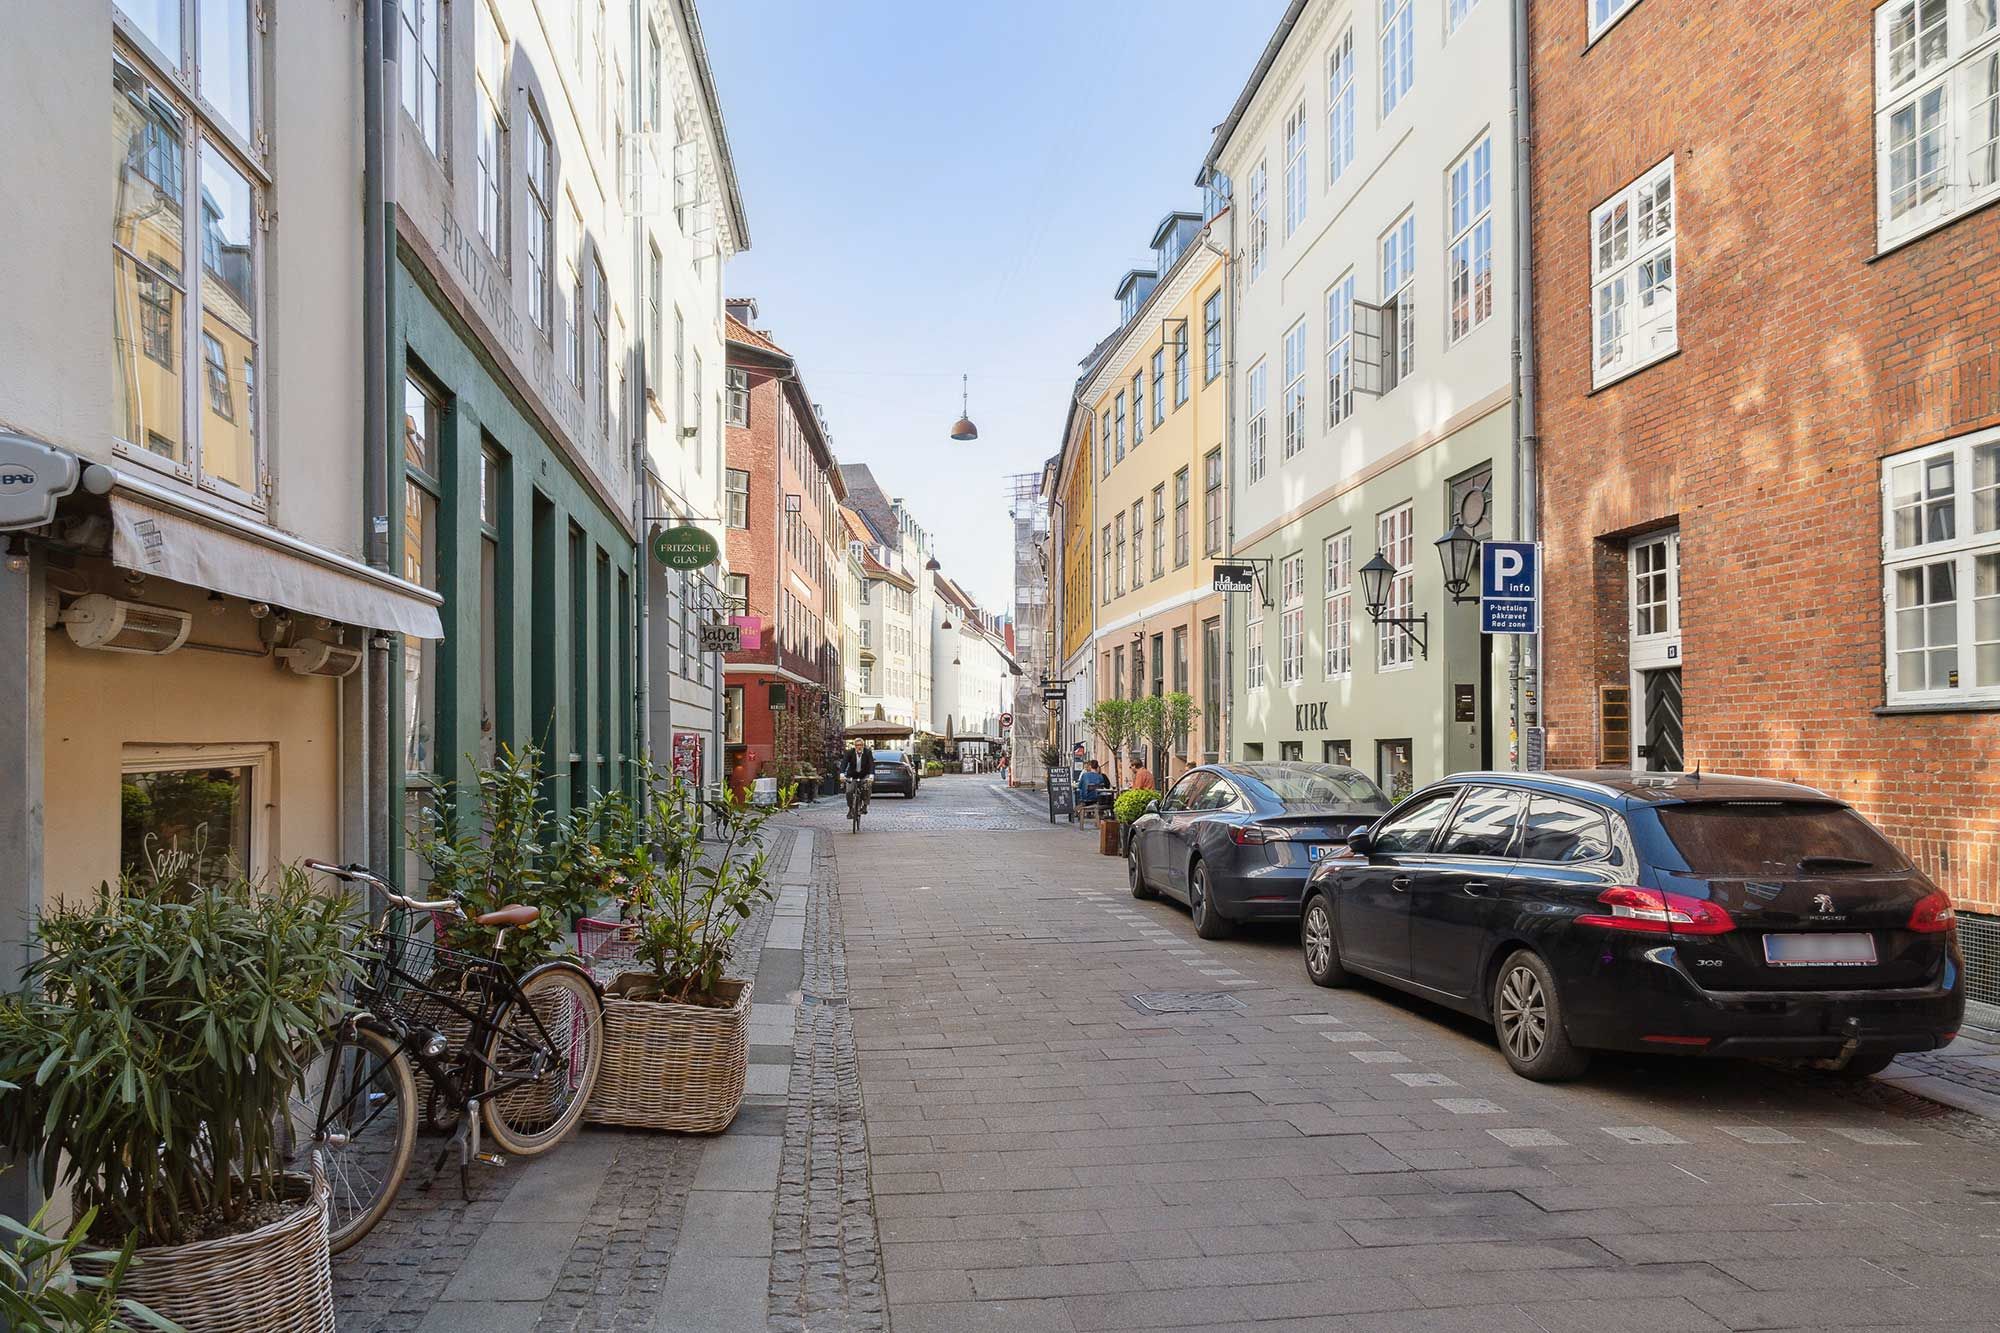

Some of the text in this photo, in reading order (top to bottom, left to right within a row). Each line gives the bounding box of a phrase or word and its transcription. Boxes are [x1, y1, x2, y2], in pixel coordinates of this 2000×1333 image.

[660, 543, 711, 553] FRITZSCHE
[672, 555, 698, 564] GLAS
[1494, 549, 1523, 591] P
[1219, 573, 1231, 584] La
[1214, 580, 1252, 591] Fontaine
[1509, 583, 1530, 592] info
[1490, 604, 1528, 613] P-betaling
[1491, 612, 1526, 620] påkrævet
[1295, 701, 1329, 732] KIRK
[1695, 959, 1724, 967] 308
